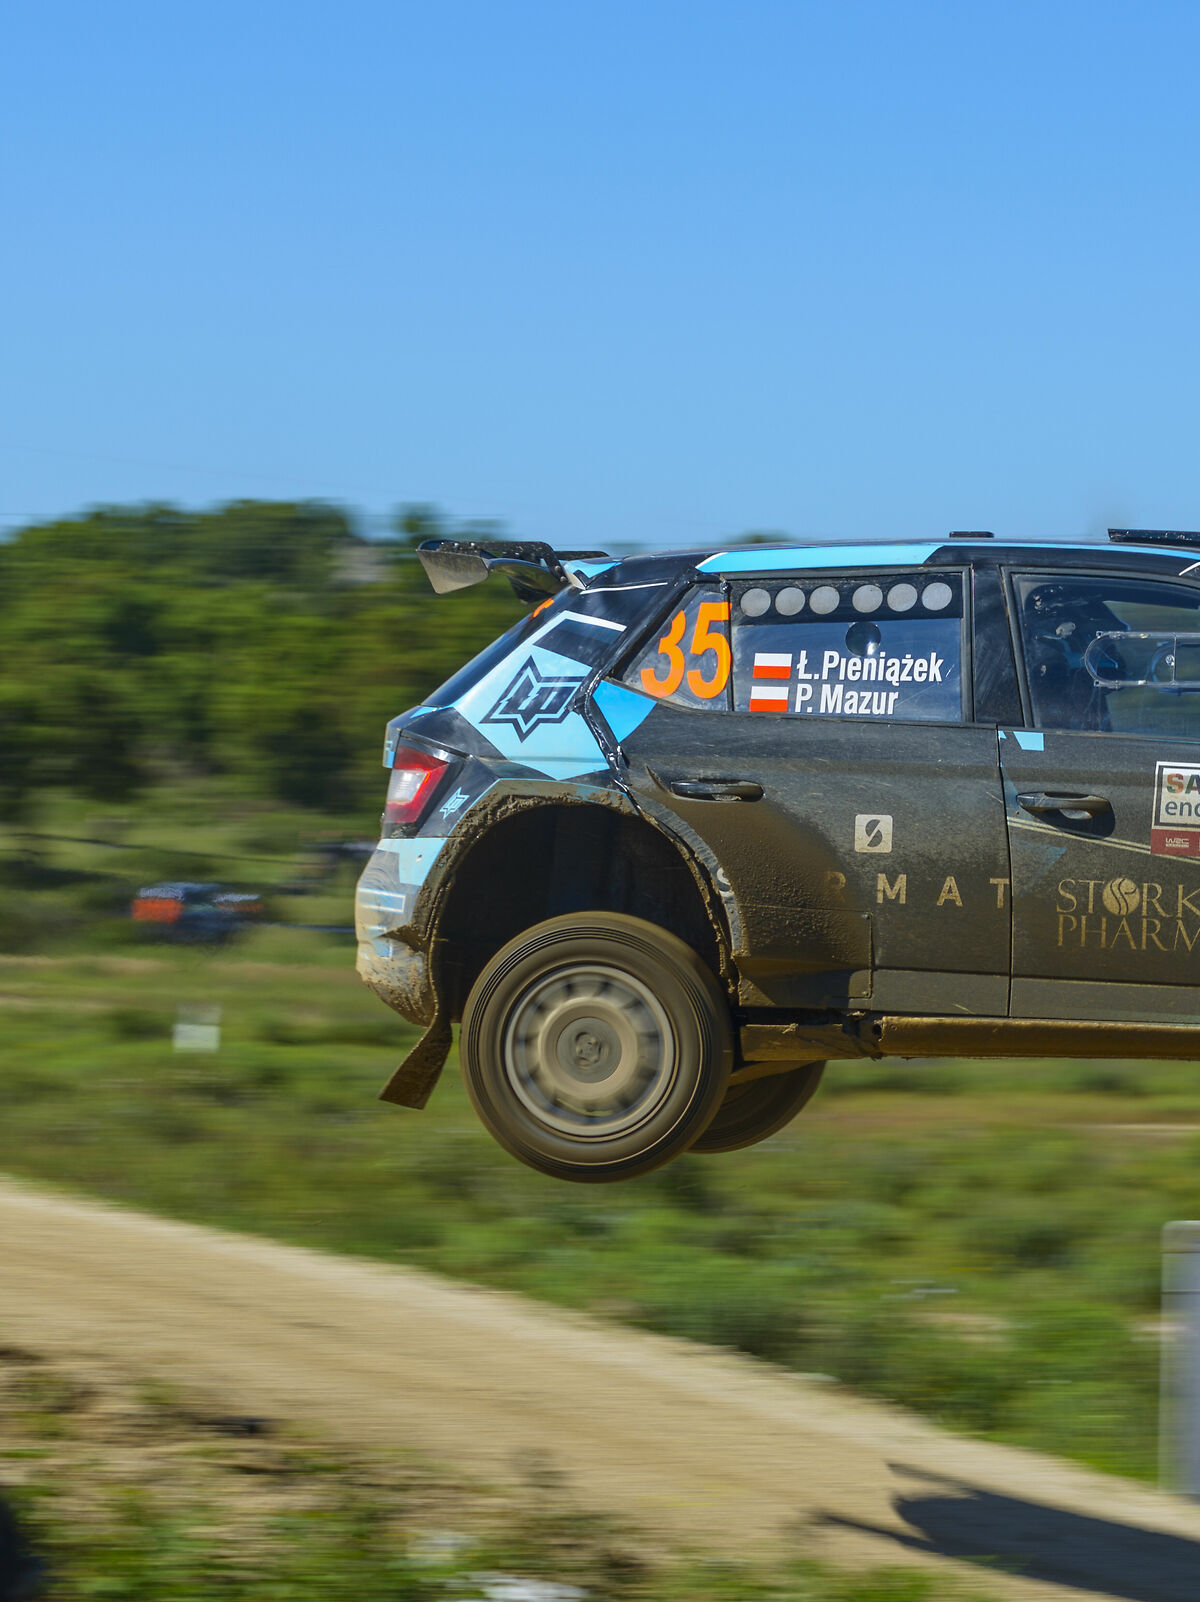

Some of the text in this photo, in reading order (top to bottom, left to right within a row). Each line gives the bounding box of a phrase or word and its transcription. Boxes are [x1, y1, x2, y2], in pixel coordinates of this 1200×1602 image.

[640, 602, 732, 699] 35
[795, 684, 899, 715] P. Mazur
